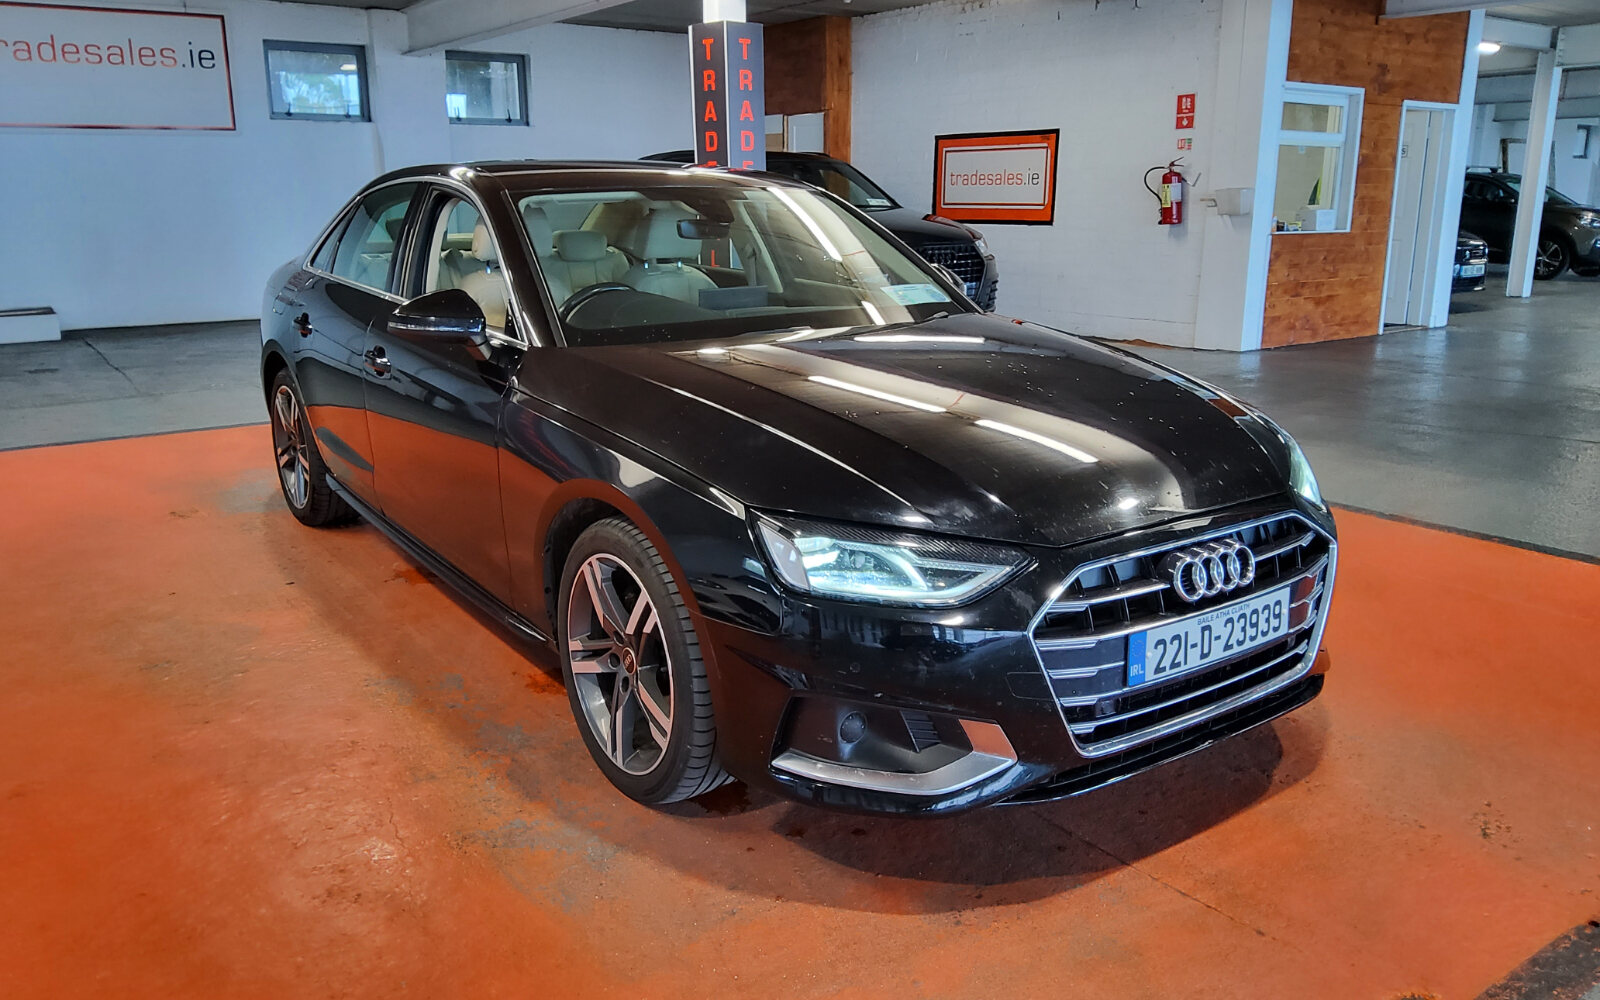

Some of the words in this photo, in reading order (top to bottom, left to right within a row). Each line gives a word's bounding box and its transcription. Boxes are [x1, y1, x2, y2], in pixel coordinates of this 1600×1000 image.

[702, 38, 719, 167] TRAD
[950, 168, 1040, 186] tradesales.ie
[1197, 614, 1215, 625] BAILE
[1153, 599, 1282, 676] 221-D-23939
[1130, 665, 1144, 677] IRL
